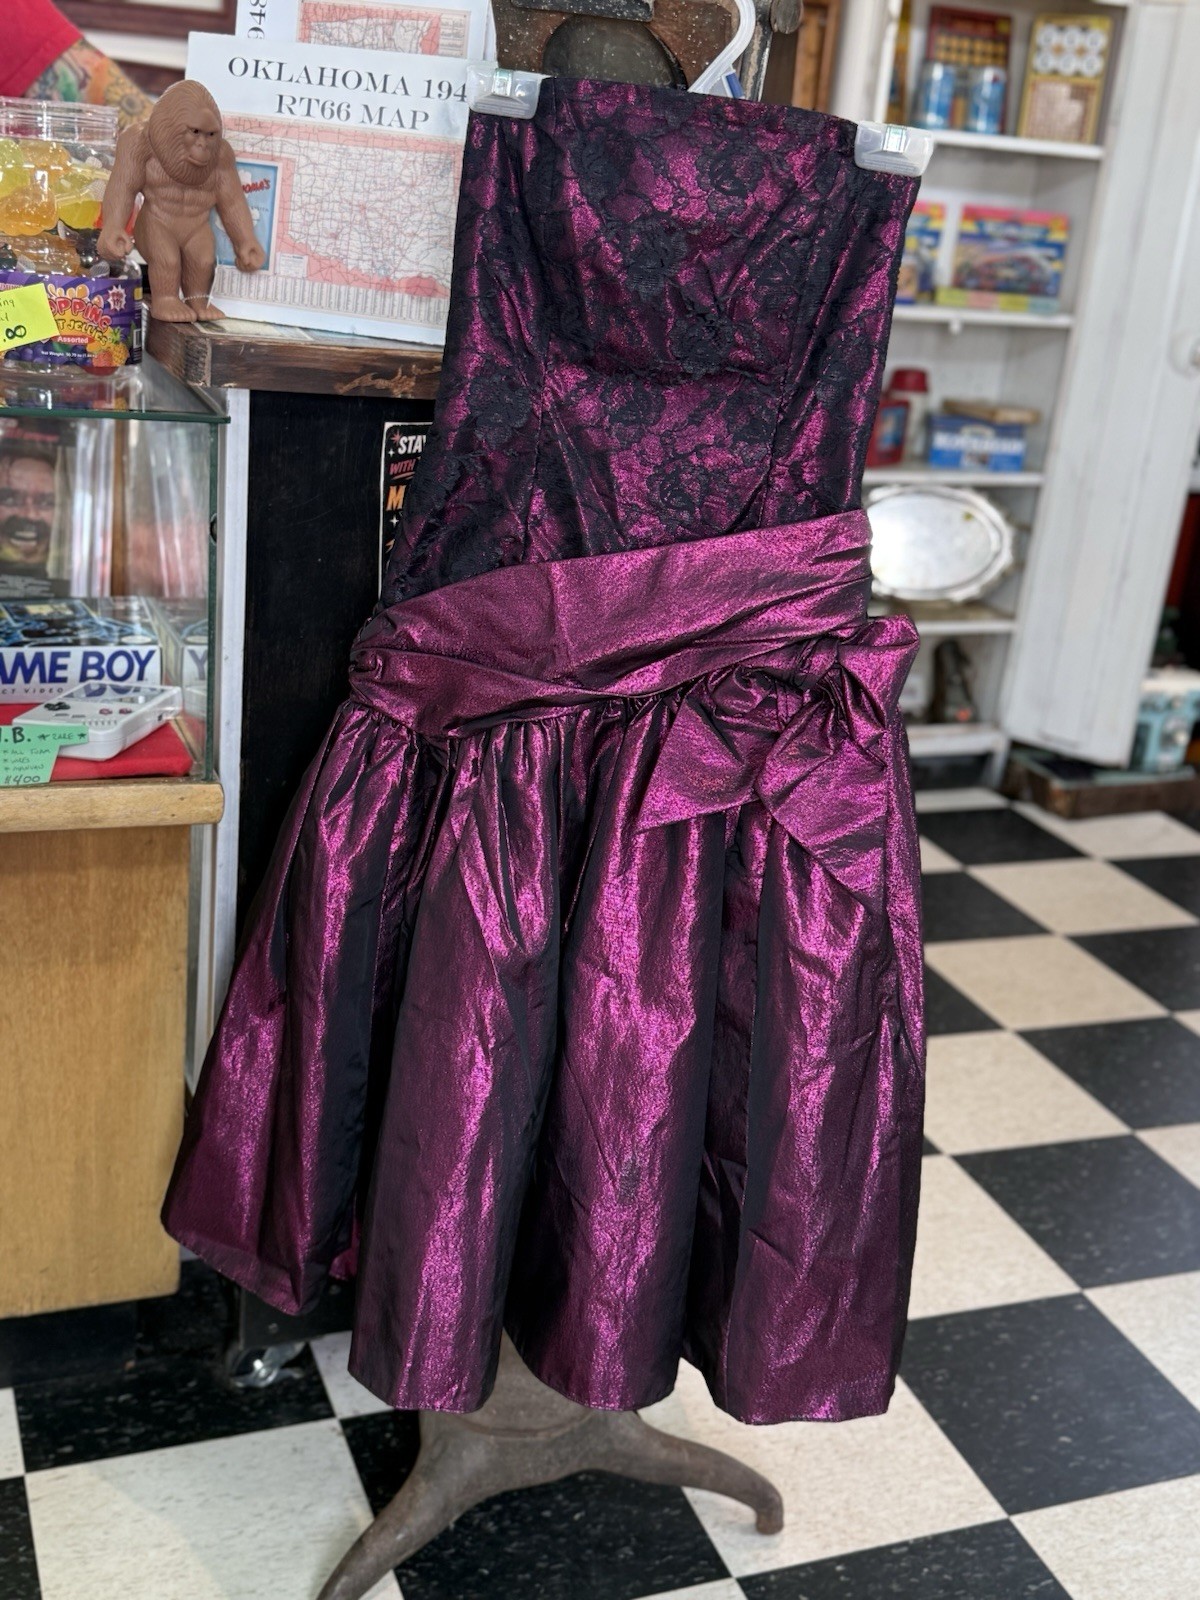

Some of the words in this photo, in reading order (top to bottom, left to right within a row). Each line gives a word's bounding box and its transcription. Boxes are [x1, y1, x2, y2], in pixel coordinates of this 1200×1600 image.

[228, 56, 410, 97] OKLAHOMA
[277, 94, 351, 122] RT66
[360, 104, 429, 131] MAP
[57, 336, 89, 345] Assorted
[66, 319, 109, 347] JELLIES
[390, 459, 416, 475] WITH
[79, 650, 156, 683] BOY
